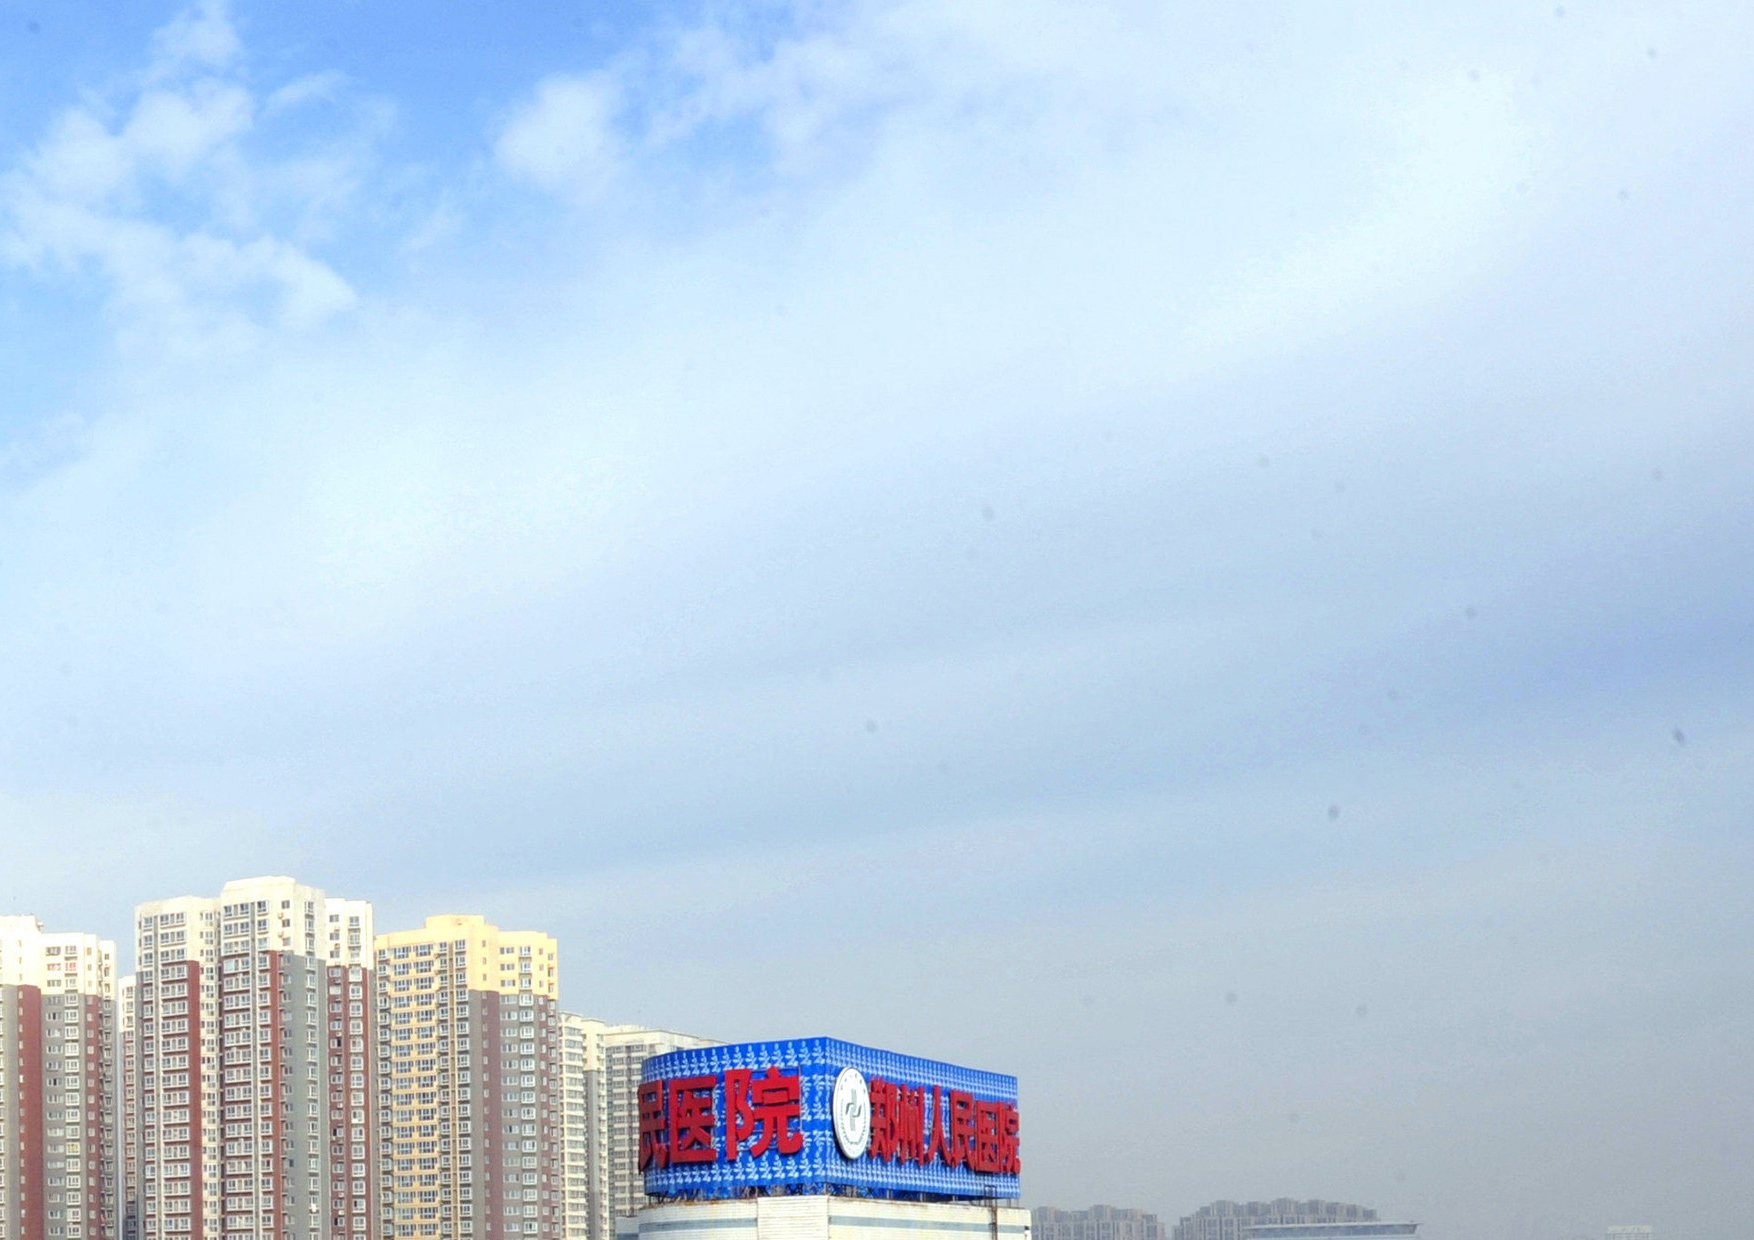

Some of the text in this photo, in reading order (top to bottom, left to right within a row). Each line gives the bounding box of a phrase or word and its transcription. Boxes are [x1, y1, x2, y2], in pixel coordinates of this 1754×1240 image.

[868, 1077, 1021, 1175] 郑州人民医院
